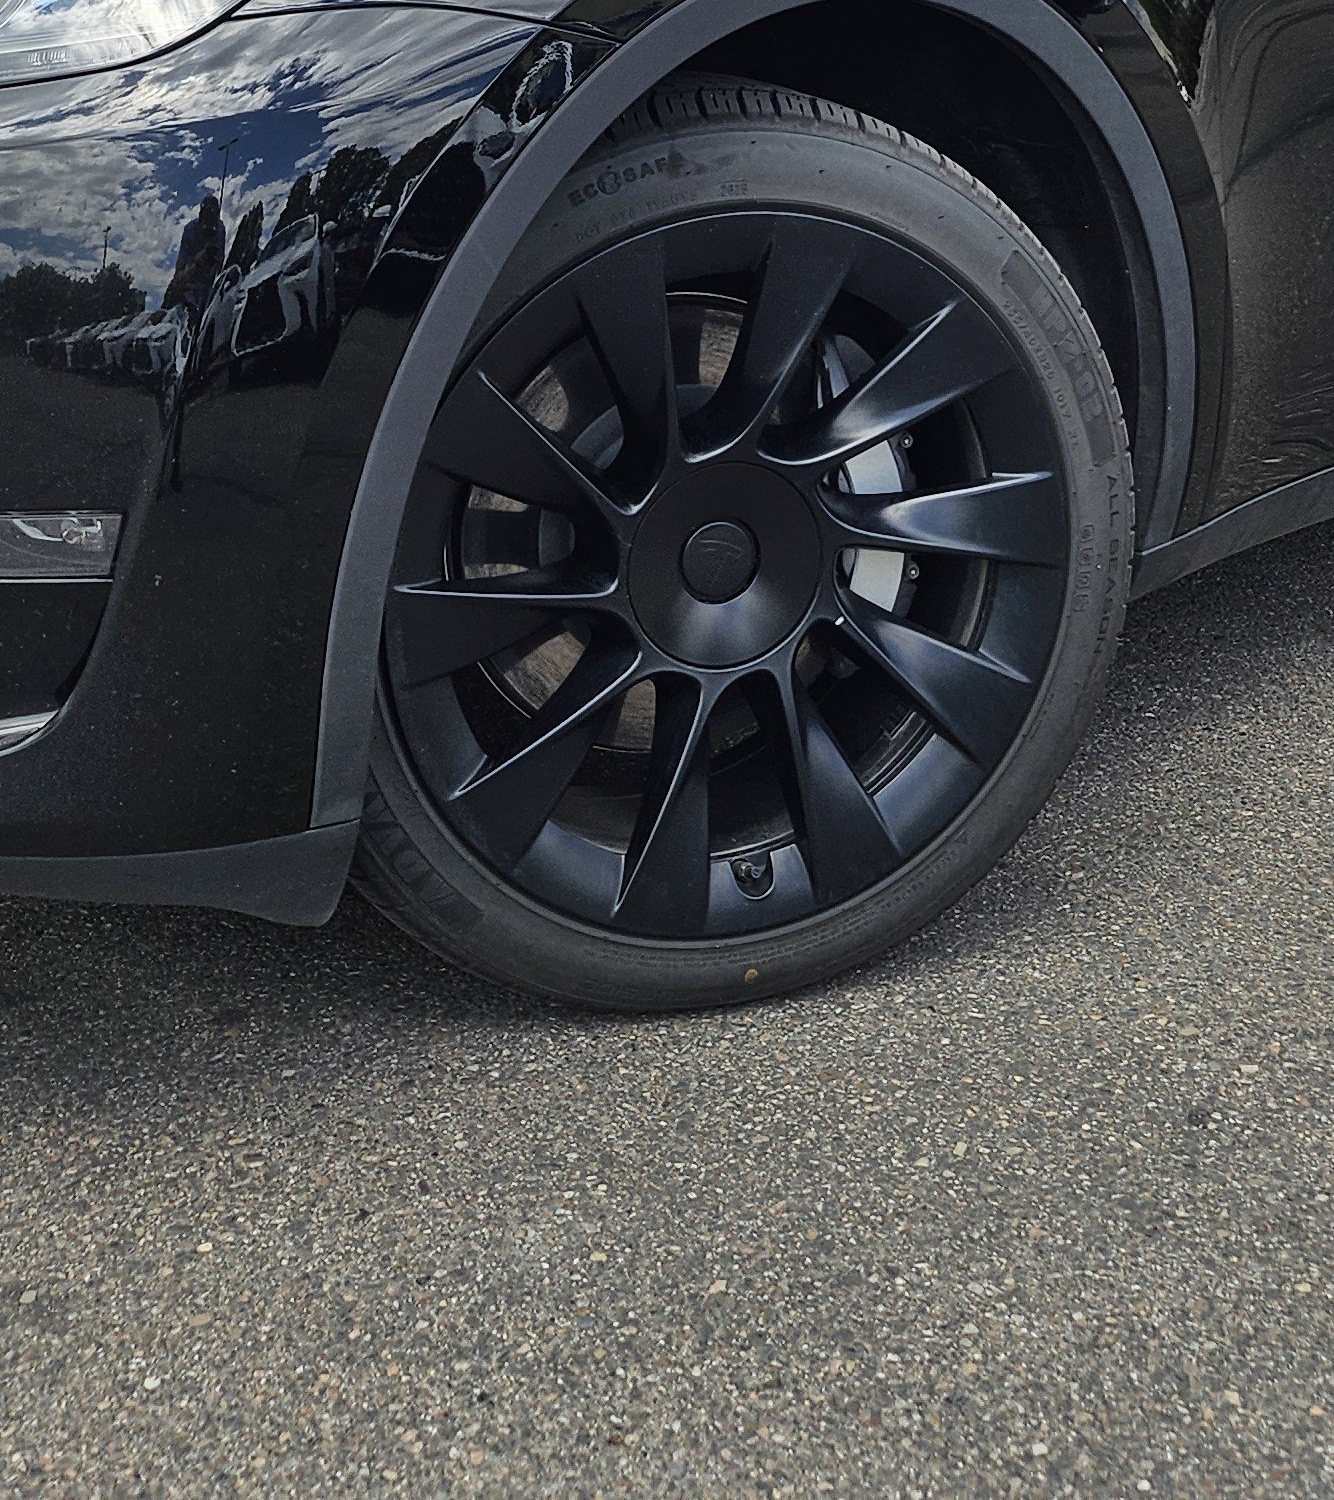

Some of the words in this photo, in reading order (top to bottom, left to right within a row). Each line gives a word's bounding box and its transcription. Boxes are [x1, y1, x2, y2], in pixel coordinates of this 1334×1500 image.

[567, 156, 673, 208] ECOSAF
[1107, 475, 1120, 528] ALL
[1093, 538, 1120, 654] SEASON
